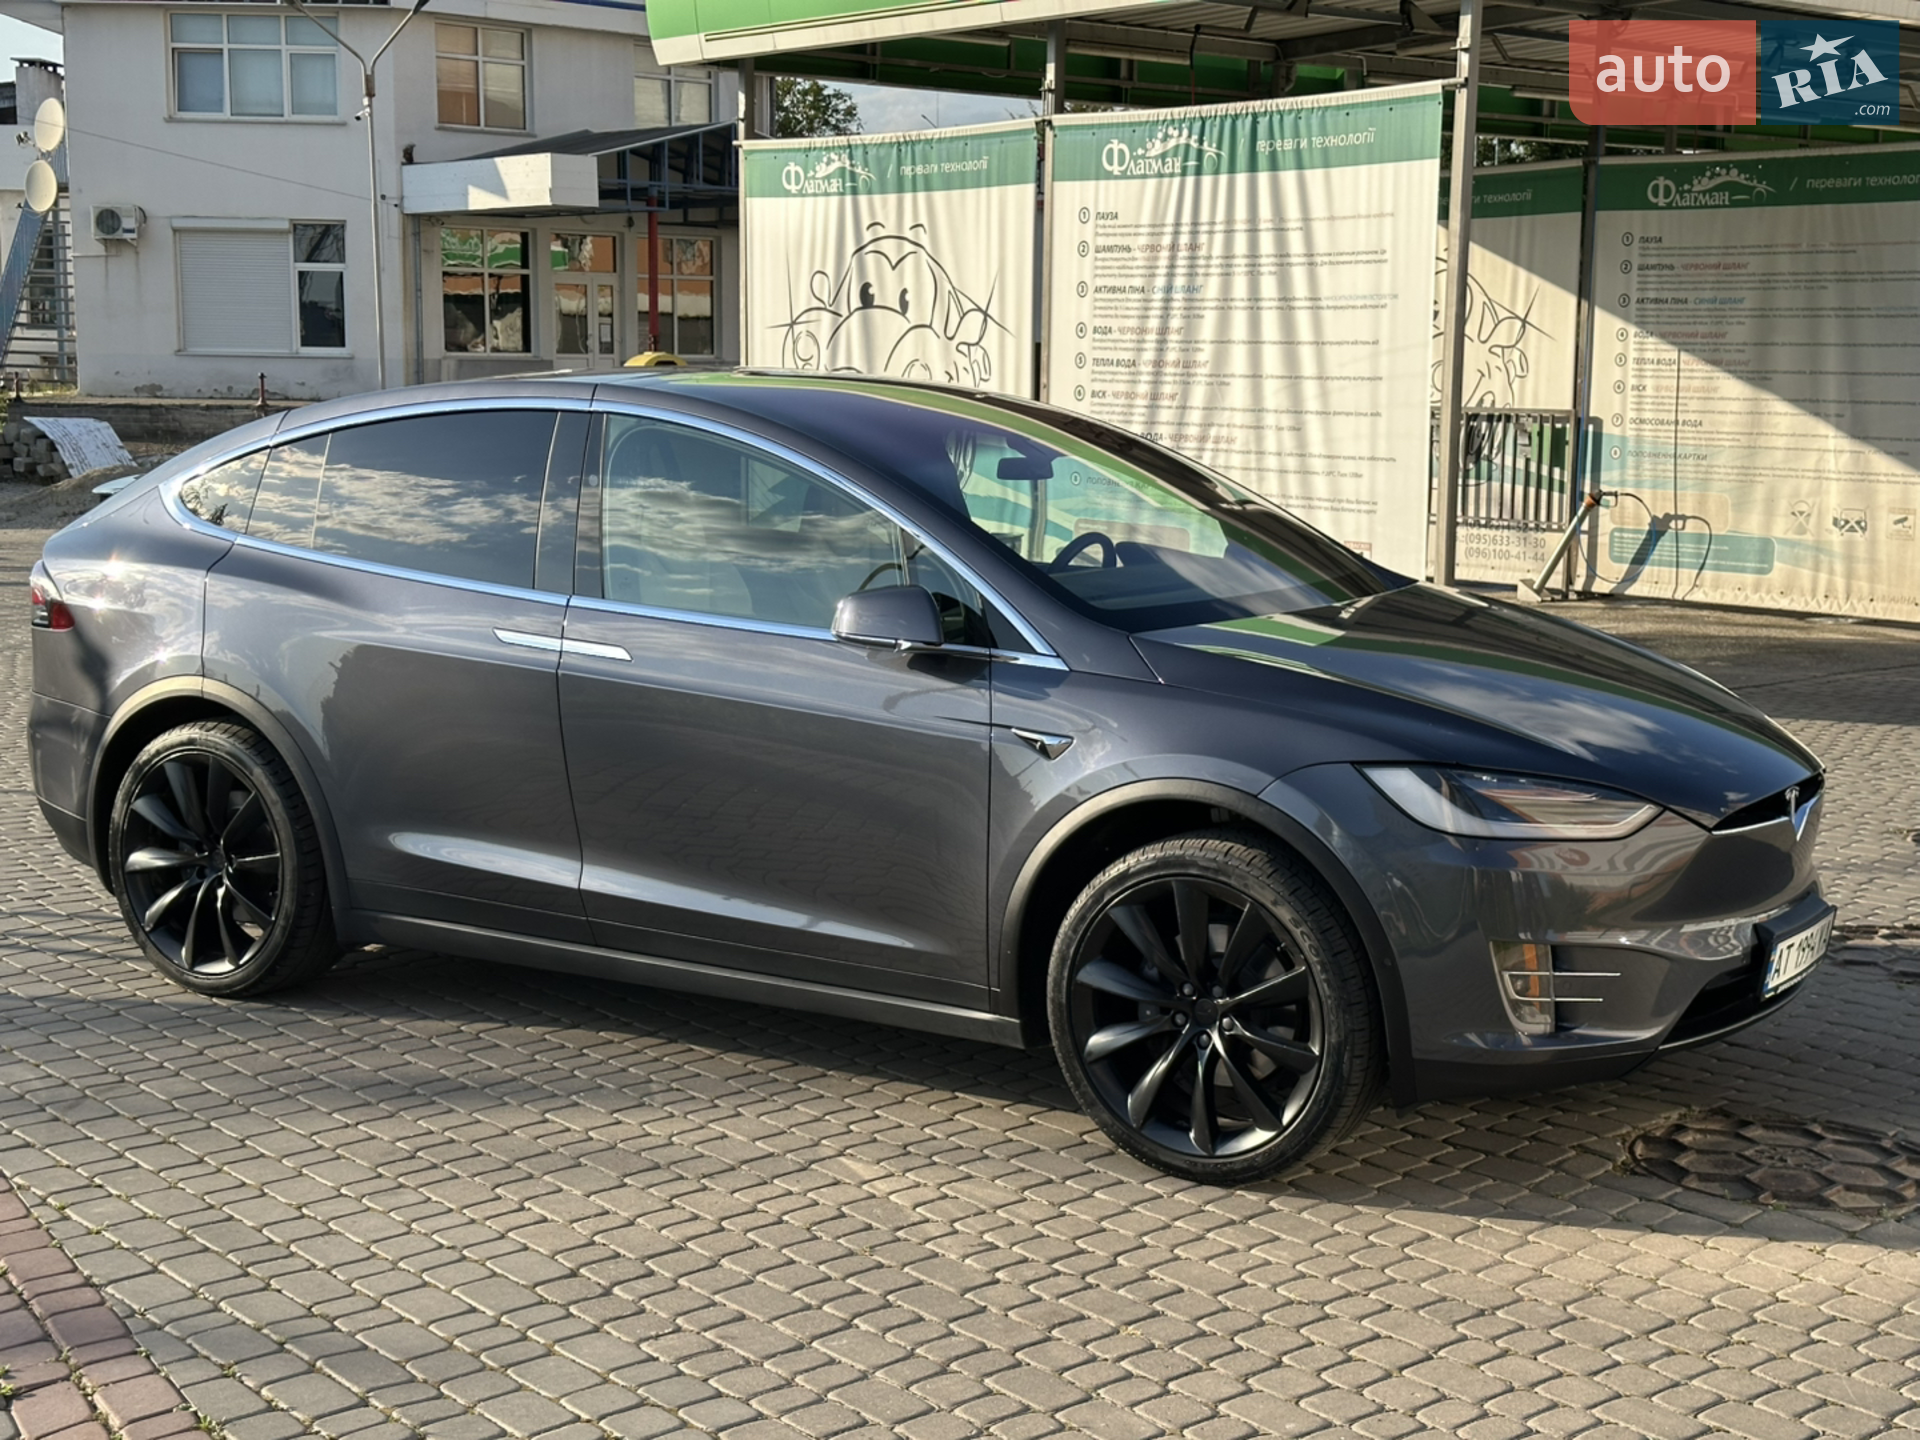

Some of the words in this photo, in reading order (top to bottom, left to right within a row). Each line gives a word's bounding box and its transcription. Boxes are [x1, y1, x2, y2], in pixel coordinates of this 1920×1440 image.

[1311, 127, 1376, 148] технології
[1101, 138, 1182, 176] Флагман
[1647, 176, 1730, 207] Флагман
[1806, 177, 1862, 191] переваги
[1092, 326, 1112, 336] ВОДА
[1464, 546, 1545, 563] (096)100-41-44
